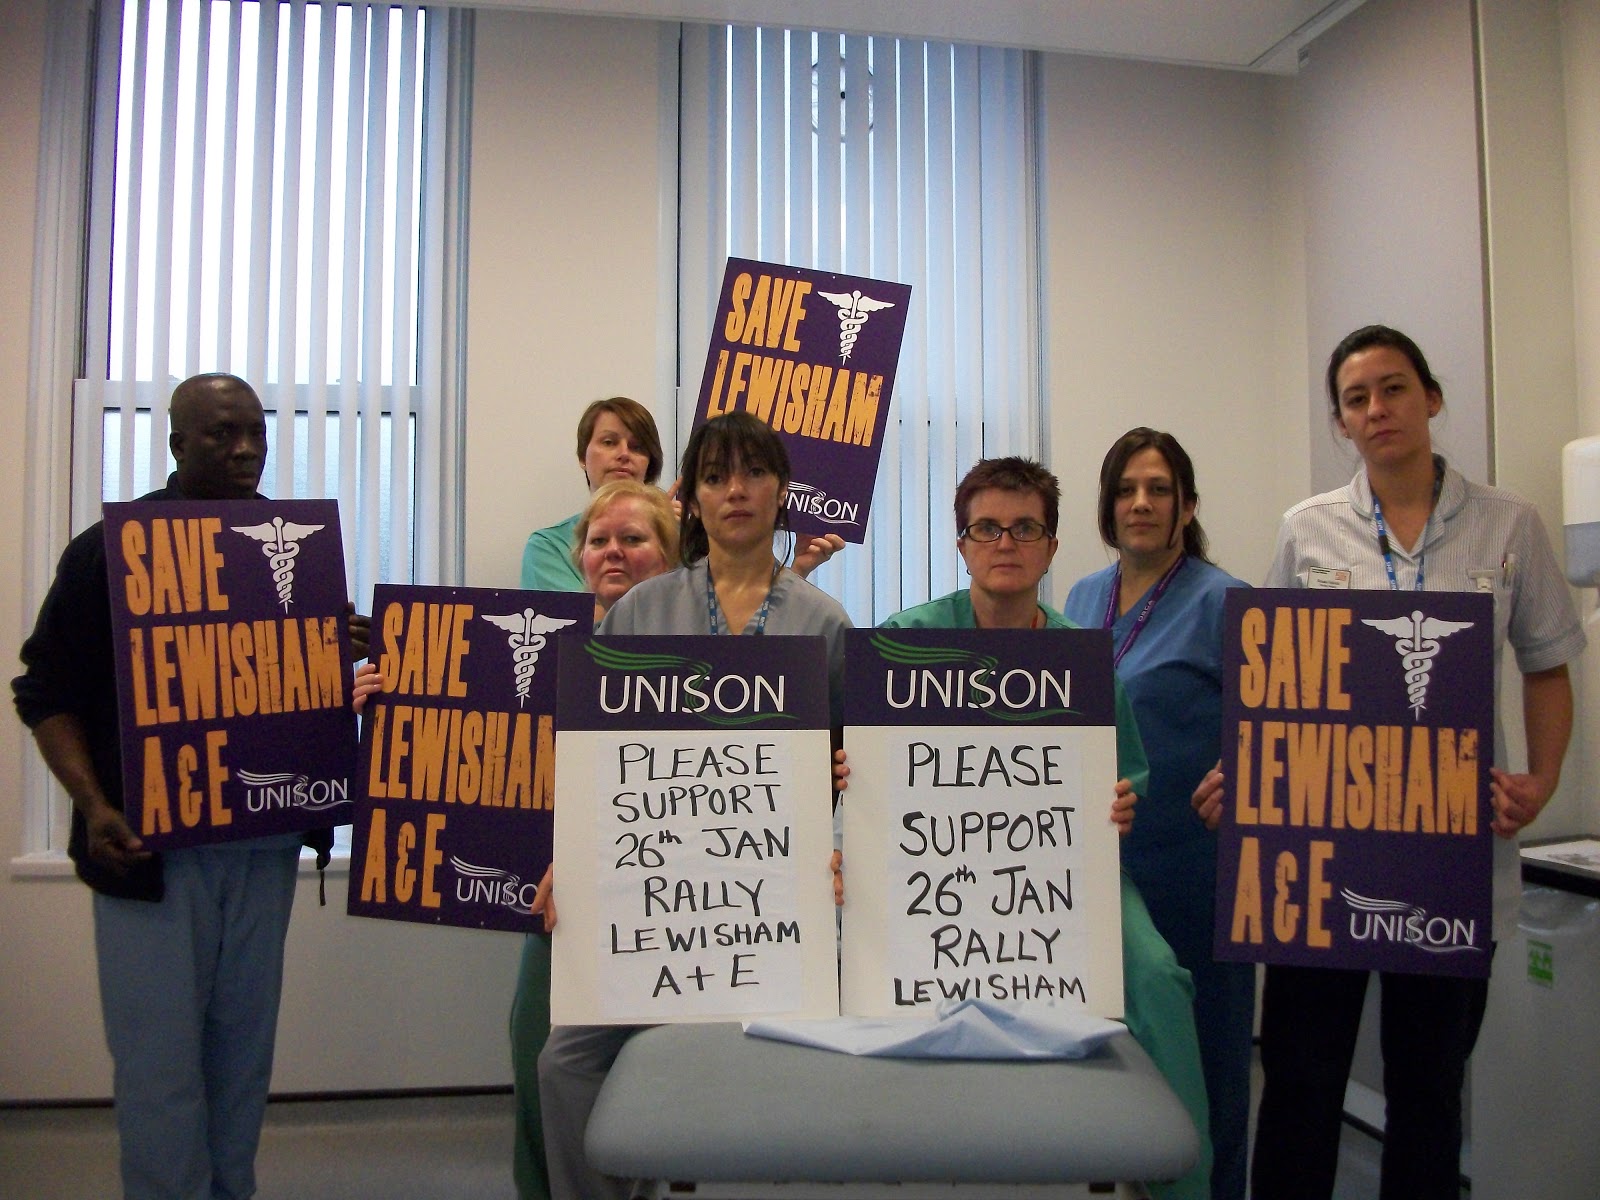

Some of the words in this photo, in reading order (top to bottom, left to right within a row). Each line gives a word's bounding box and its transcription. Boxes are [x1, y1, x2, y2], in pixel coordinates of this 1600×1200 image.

[725, 273, 812, 352] SAVE
[707, 350, 883, 447] LEWISHAM
[785, 492, 858, 521] NISON
[122, 518, 228, 615] SAVE
[383, 602, 473, 697] SAVE
[1240, 607, 1351, 710] SAVE
[130, 618, 342, 725] LEWISHAM
[887, 669, 1070, 708] UNISON
[600, 675, 784, 713] UNISON
[619, 743, 779, 784] PLEASE
[908, 742, 1062, 787] PLEASE
[1236, 721, 1477, 834] LEWISHAM
[247, 777, 348, 812] UNISON
[613, 784, 781, 823] SUPPORT
[616, 830, 682, 869] 26th
[702, 827, 789, 860] JAN
[900, 807, 1075, 856] SUPPORT
[456, 877, 539, 908] UNISO
[644, 876, 763, 916] RALLY
[907, 865, 976, 916] 26th
[992, 865, 1072, 915] JAN
[612, 921, 800, 956] LEWISHAM
[931, 925, 1060, 969] RALLY
[1350, 912, 1475, 946] UNISON
[894, 974, 1085, 1005] LEWISHAM
